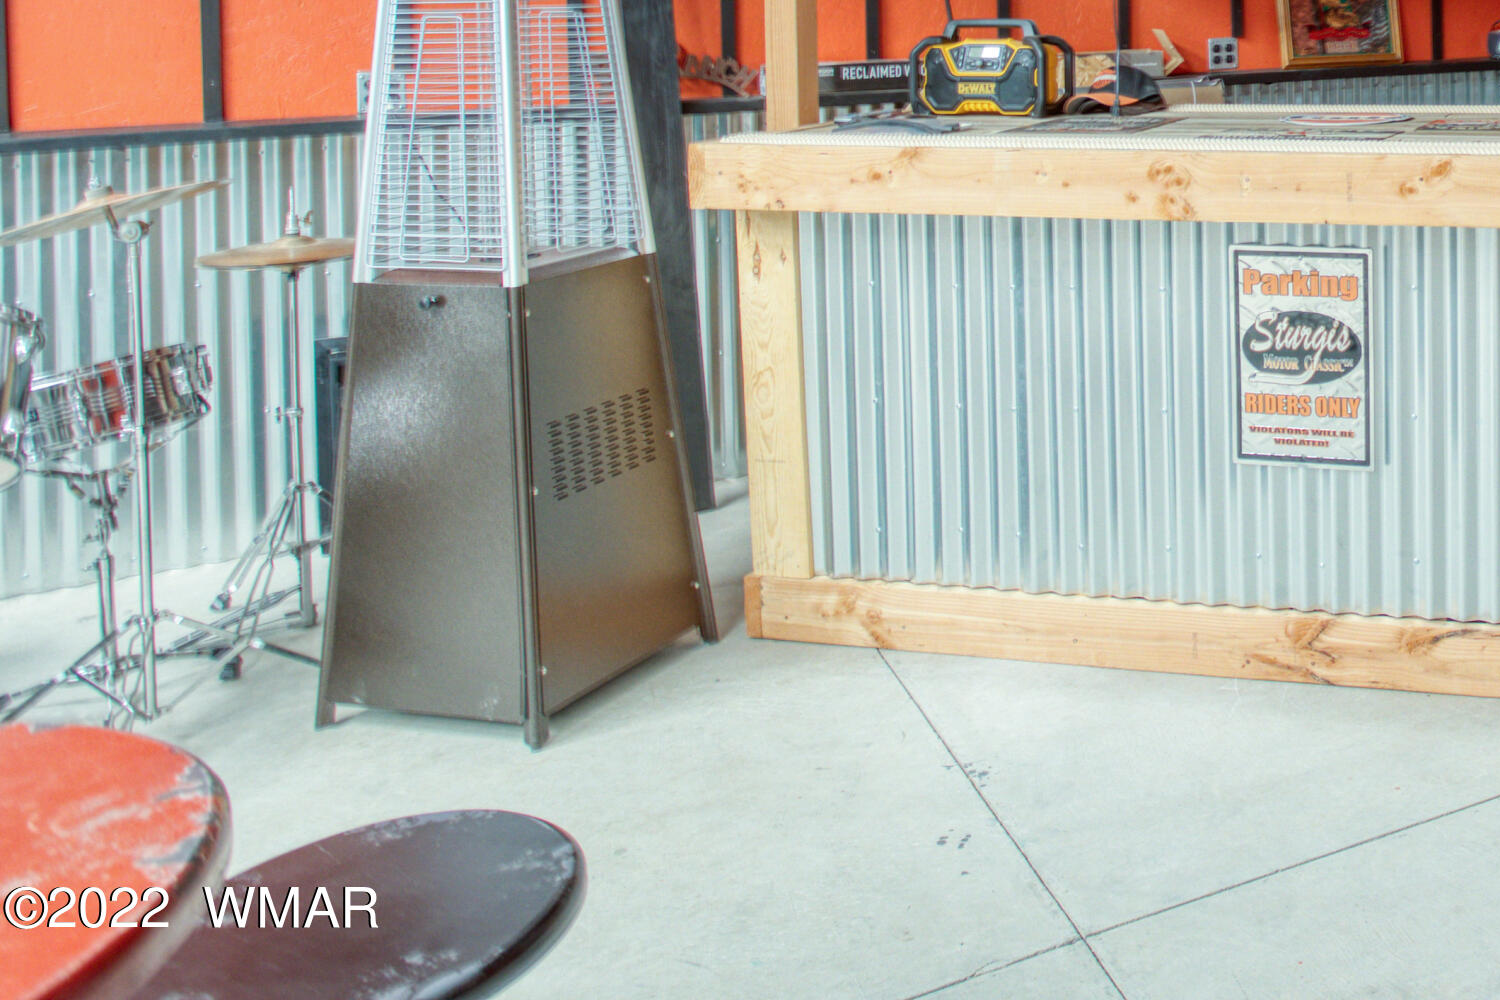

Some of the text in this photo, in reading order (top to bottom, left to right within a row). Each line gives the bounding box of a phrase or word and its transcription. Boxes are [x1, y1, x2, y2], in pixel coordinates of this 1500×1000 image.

[842, 64, 902, 80] RECLAIMED
[1242, 268, 1359, 301] Parking
[1249, 311, 1352, 364] Sturgis
[1244, 392, 1361, 419] RIDERS ONLY
[1248, 425, 1310, 436] VIOLATORS
[1311, 429, 1338, 437] WILL
[1273, 438, 1330, 448] VIOLATED!
